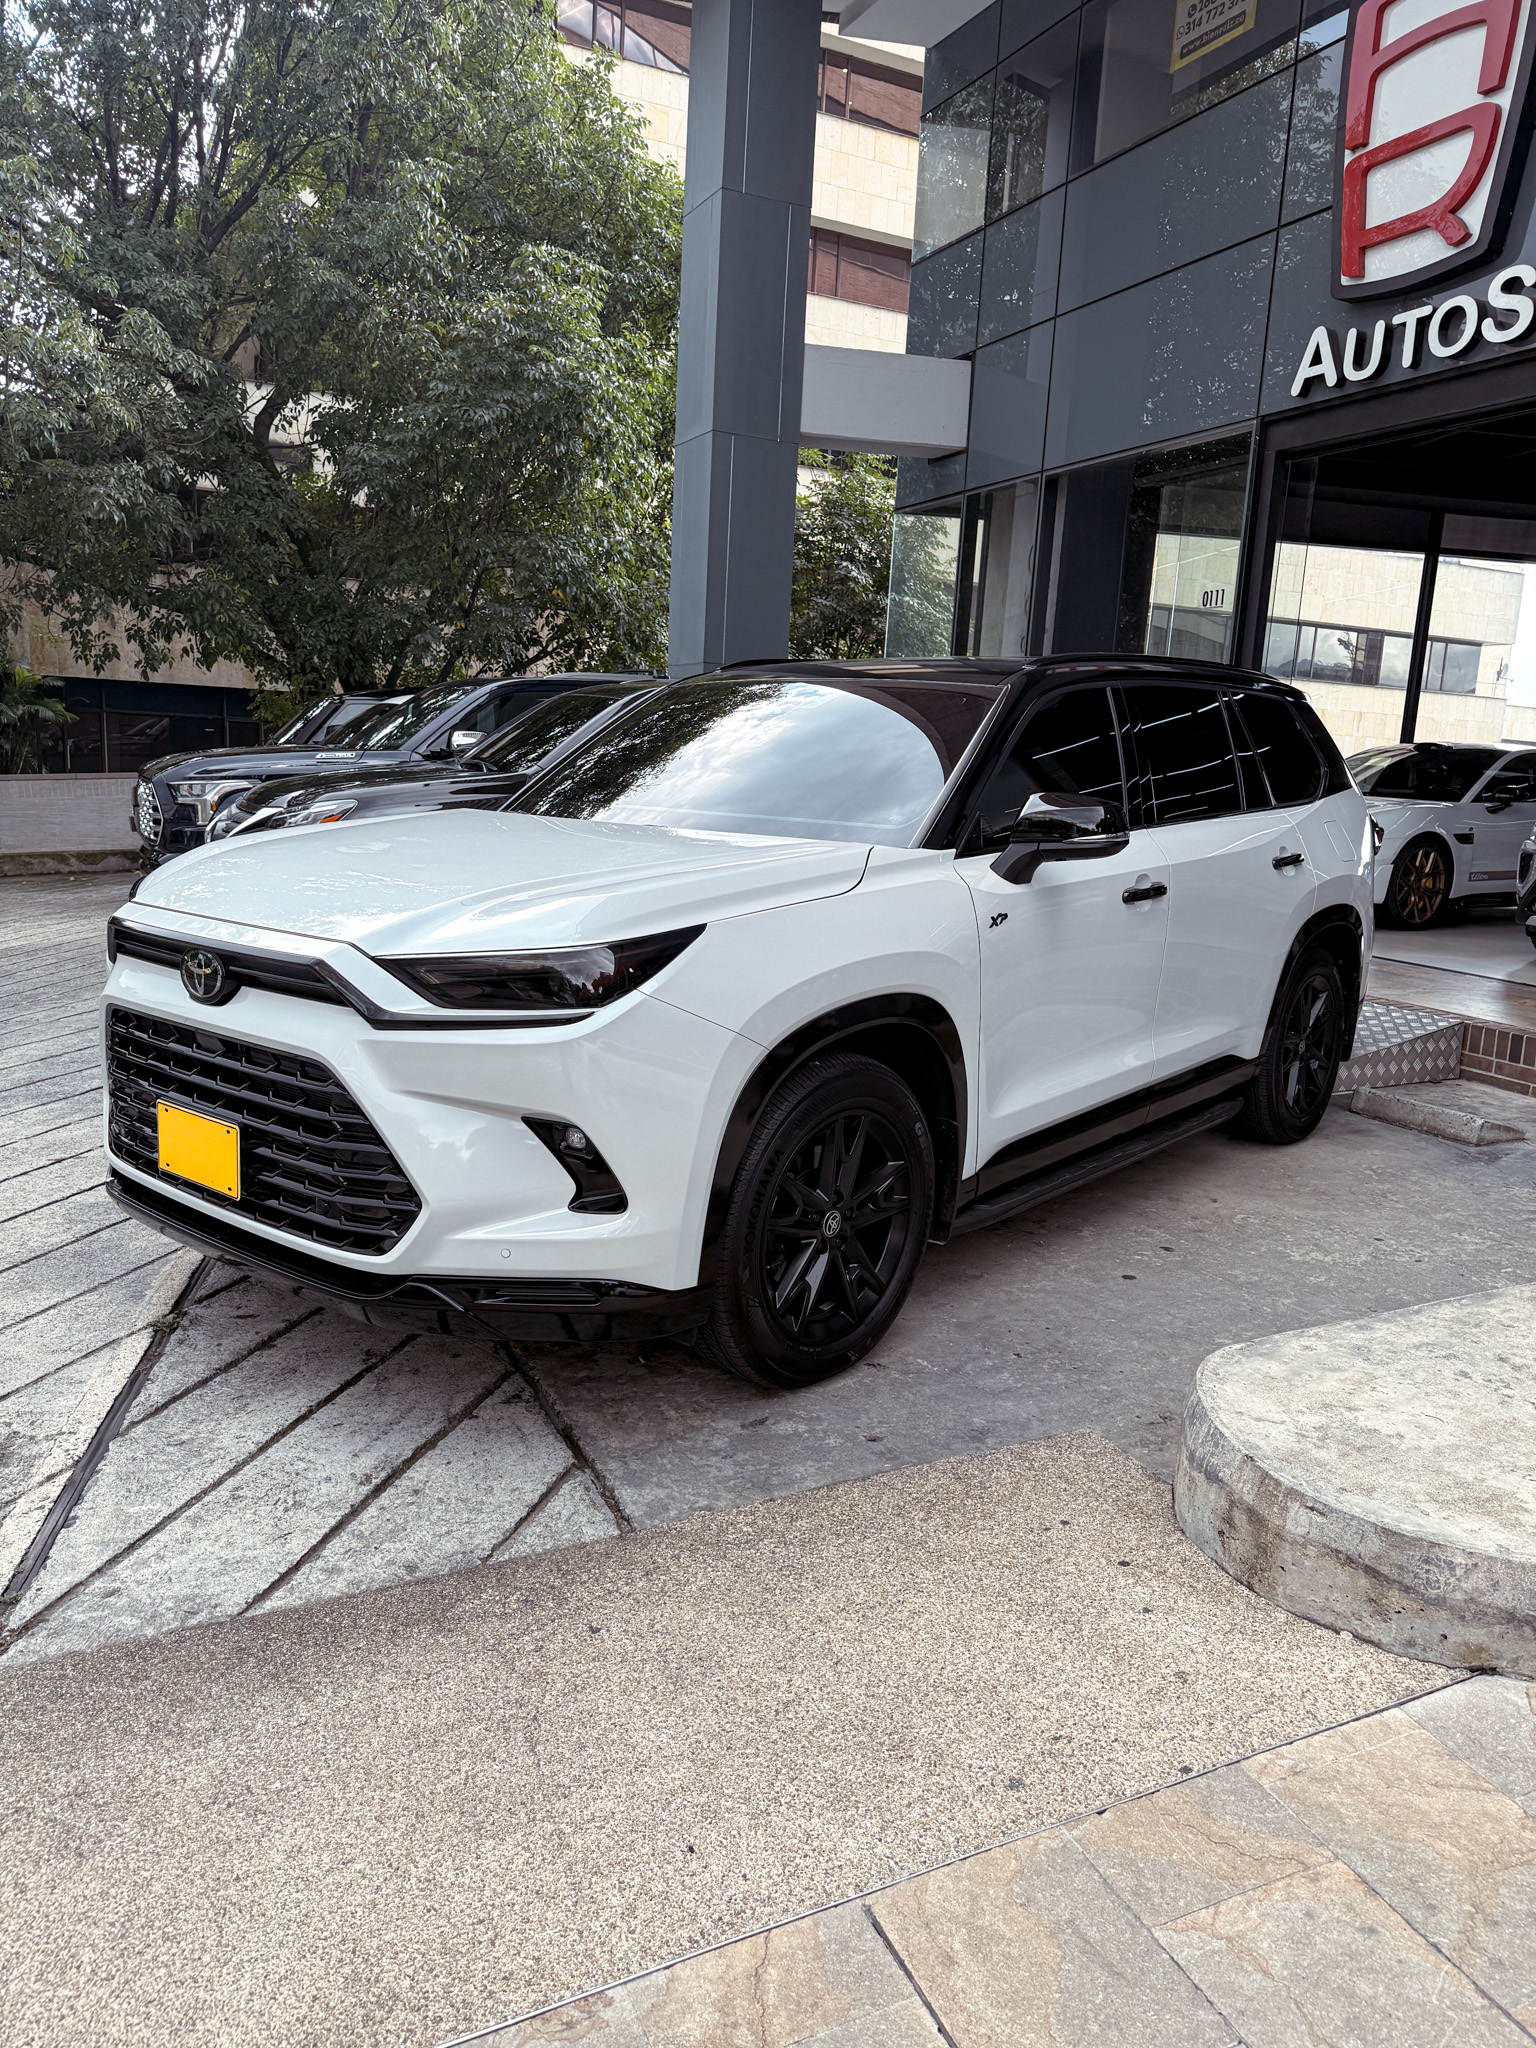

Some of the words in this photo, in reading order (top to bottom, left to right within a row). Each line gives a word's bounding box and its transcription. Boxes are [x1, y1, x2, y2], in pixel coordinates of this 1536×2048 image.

[1185, 15, 1203, 35] 314
[1206, 2, 1225, 24] 772
[1290, 264, 1536, 397] AUTOS
[1202, 589, 1225, 608] 0111
[743, 1148, 785, 1257] YOKOHAMA
